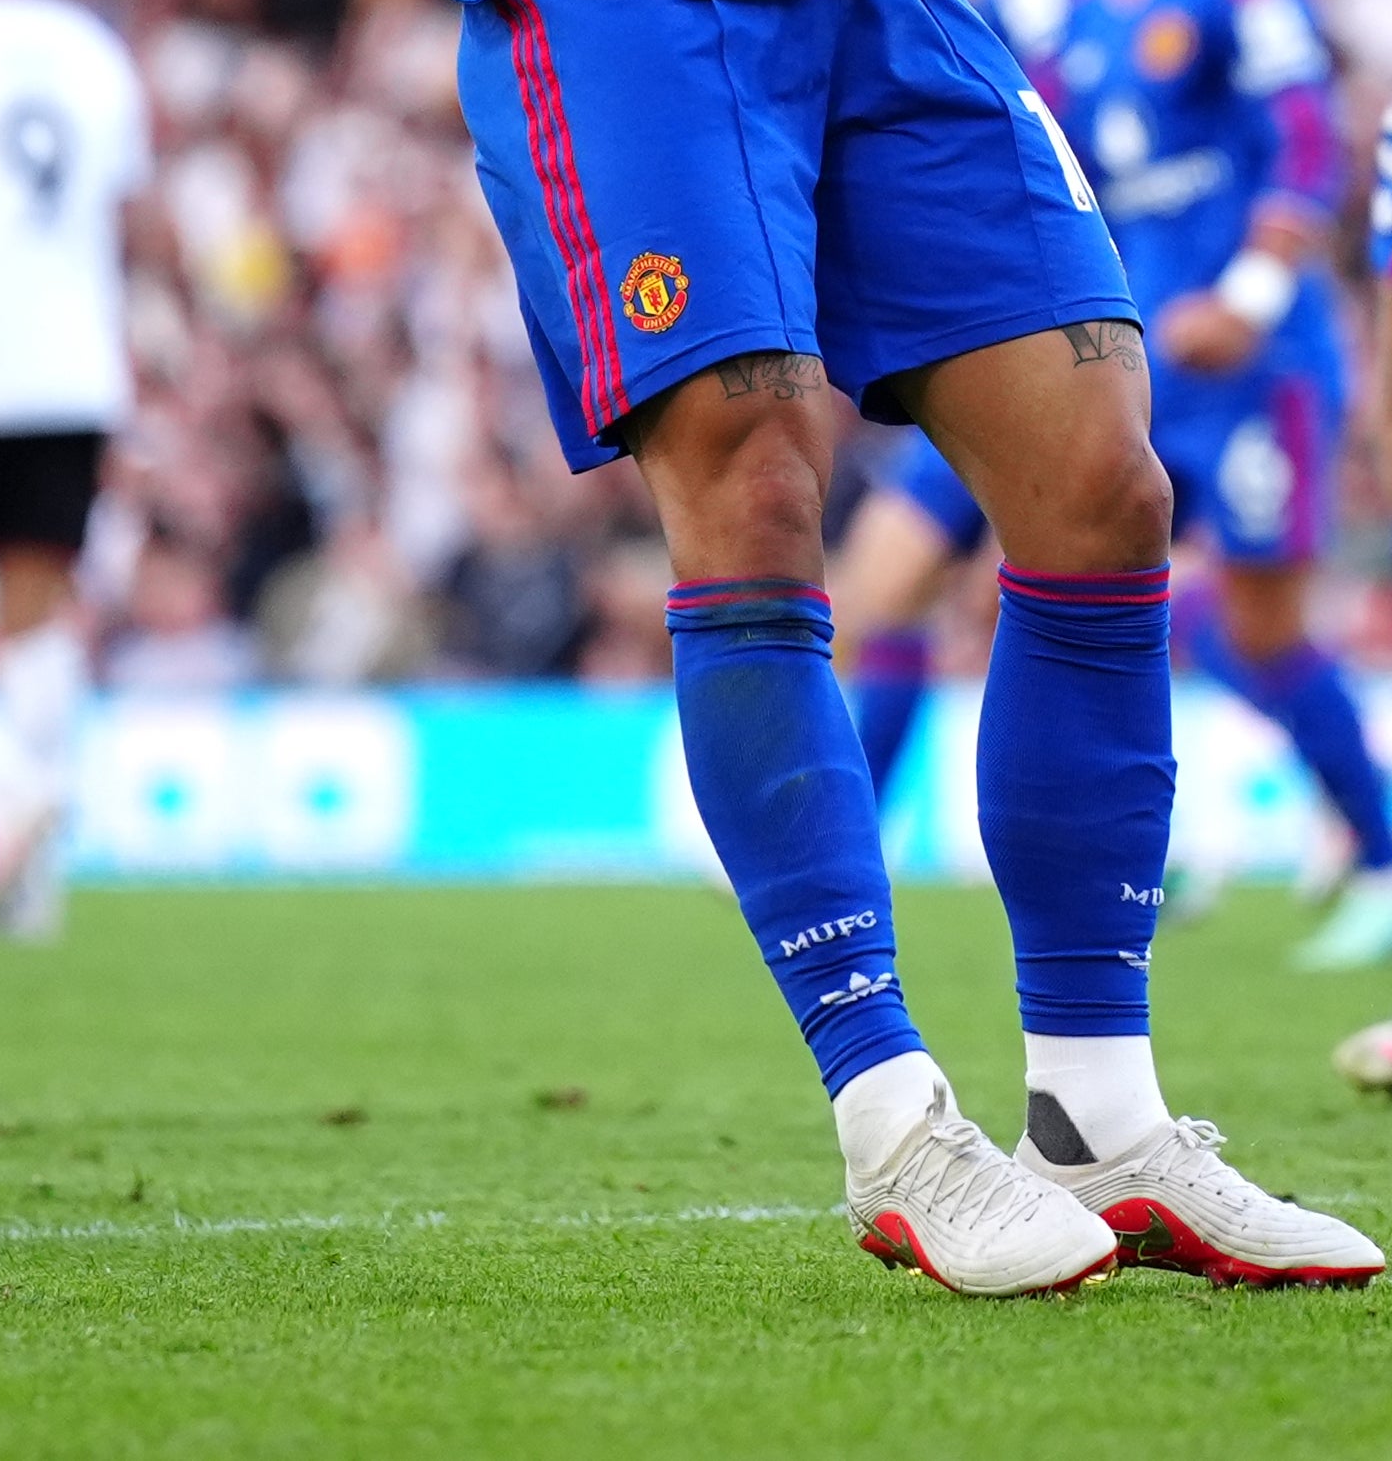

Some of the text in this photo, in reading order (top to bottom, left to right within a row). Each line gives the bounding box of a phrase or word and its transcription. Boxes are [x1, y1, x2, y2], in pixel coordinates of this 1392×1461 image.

[624, 257, 676, 297] MANCHESTER
[643, 303, 681, 329] UNITED
[780, 910, 878, 957] MUFC
